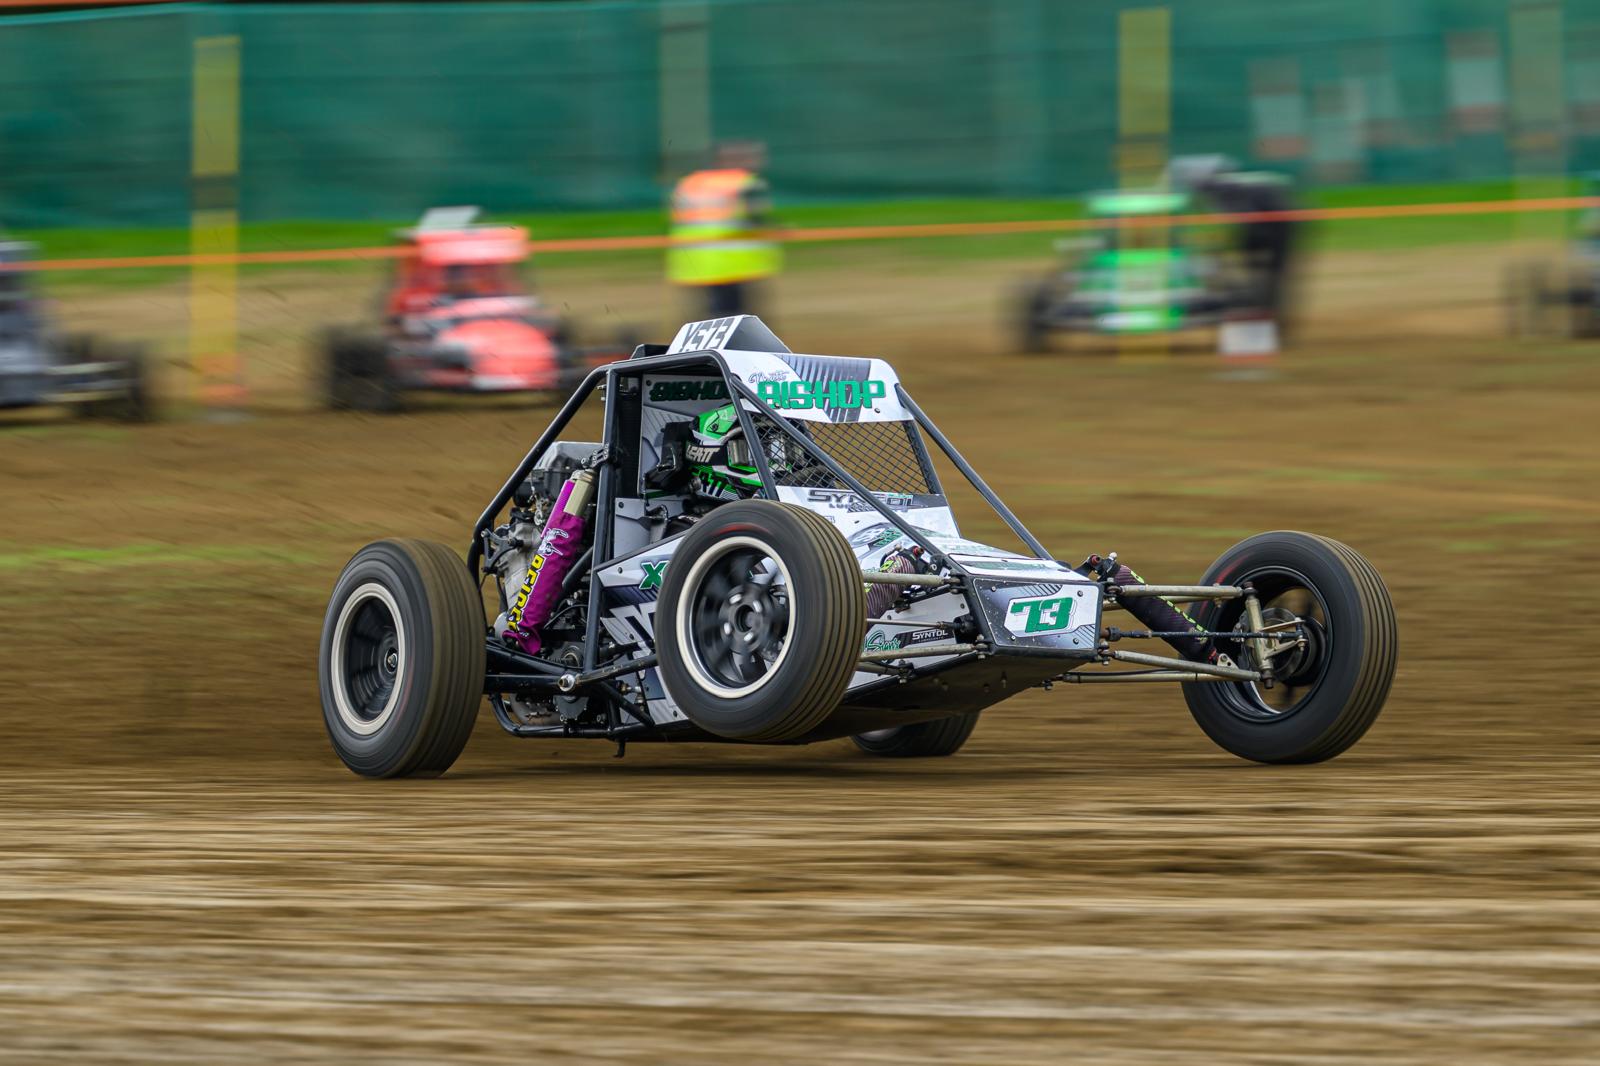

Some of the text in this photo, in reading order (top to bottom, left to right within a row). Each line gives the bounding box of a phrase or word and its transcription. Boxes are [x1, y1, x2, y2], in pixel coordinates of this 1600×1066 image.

[757, 379, 886, 410] BISHOP
[1010, 597, 1075, 634] 73
[912, 629, 949, 641] SYNTOL
